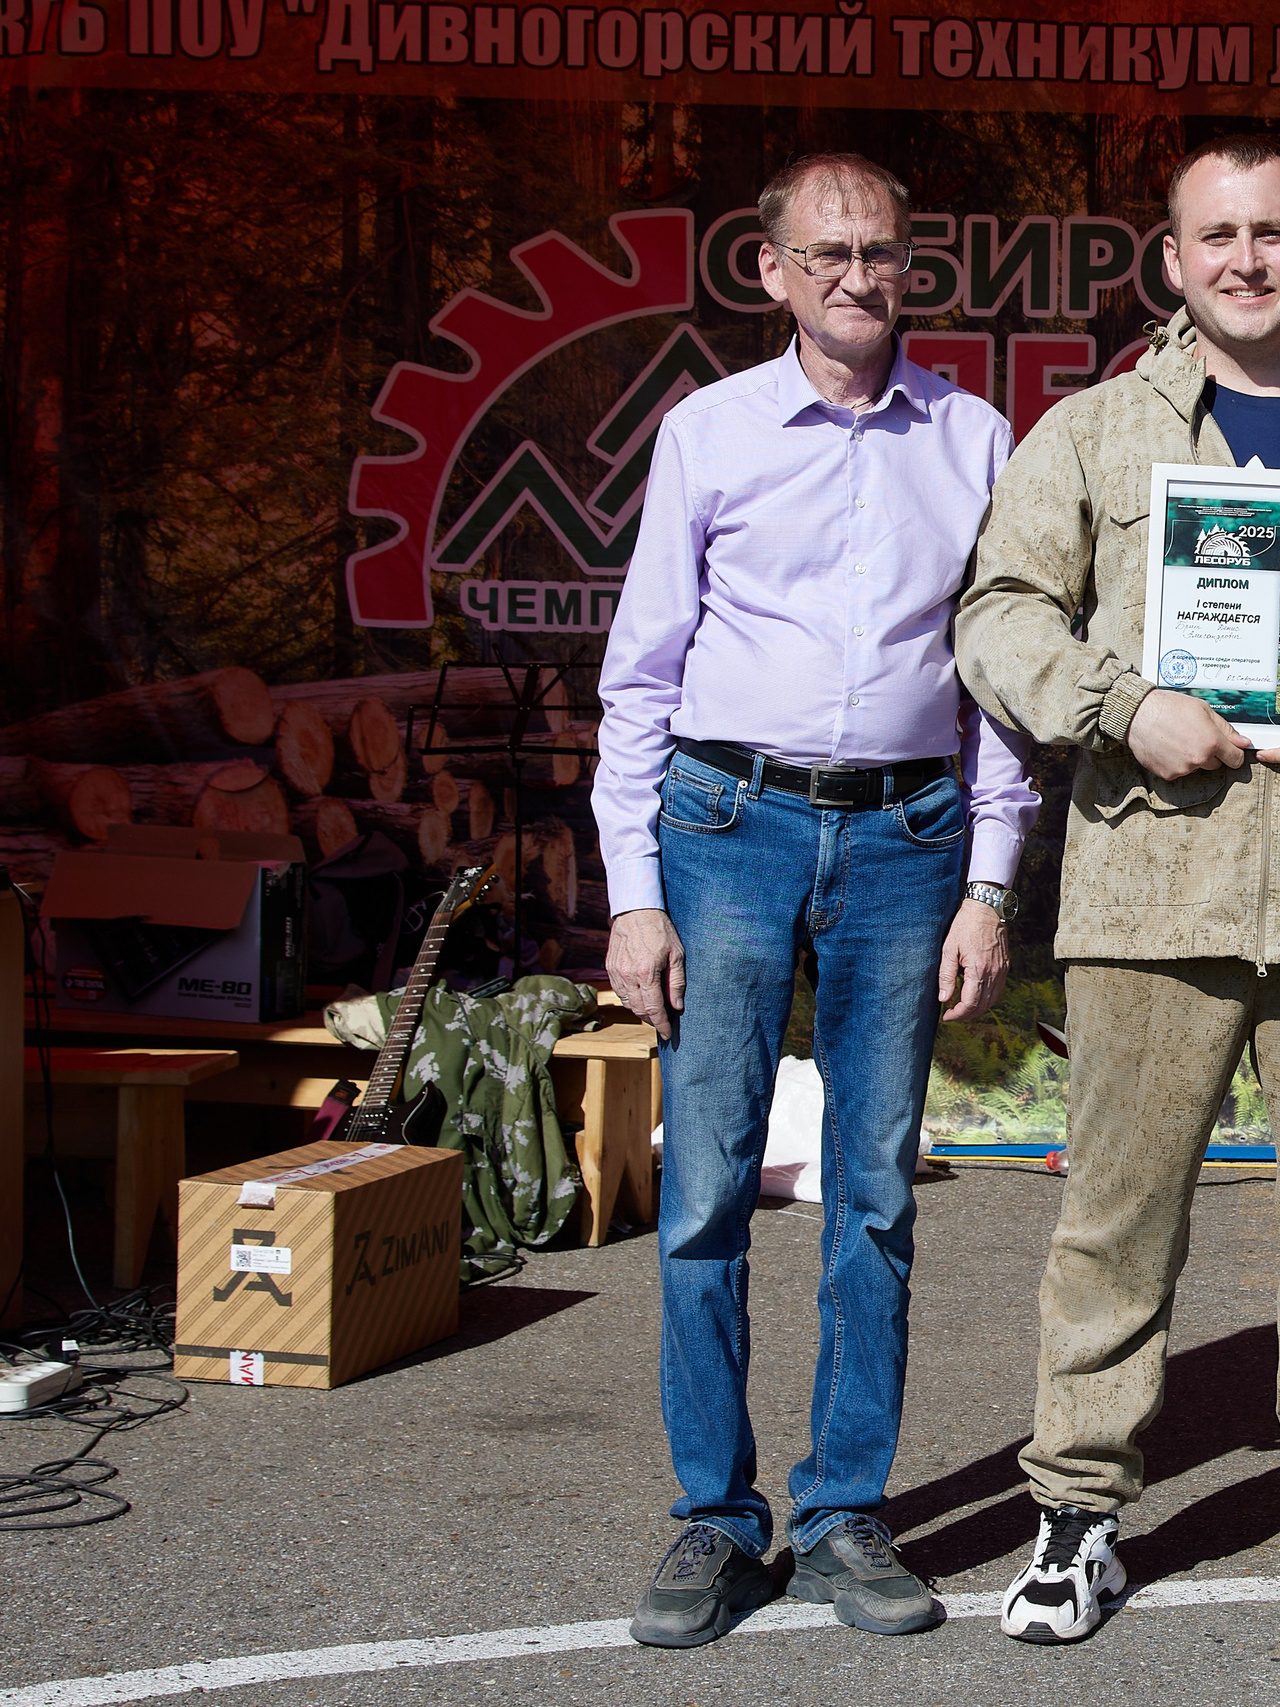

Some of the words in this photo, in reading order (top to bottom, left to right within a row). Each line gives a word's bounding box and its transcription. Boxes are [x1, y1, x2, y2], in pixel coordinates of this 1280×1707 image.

[283, 0, 876, 78] "Дивногорский
[891, 16, 1253, 91] техникум
[1238, 525, 1274, 538] 2025
[1194, 556, 1251, 566] ЛЕСОРУБ
[1196, 577, 1249, 590] ДИПЛОМ
[1202, 601, 1242, 610] степени
[1177, 611, 1261, 624] НАГРАЖДАЕТСЯ
[178, 977, 252, 996] ME-80
[382, 1221, 449, 1277] ZIMANI
